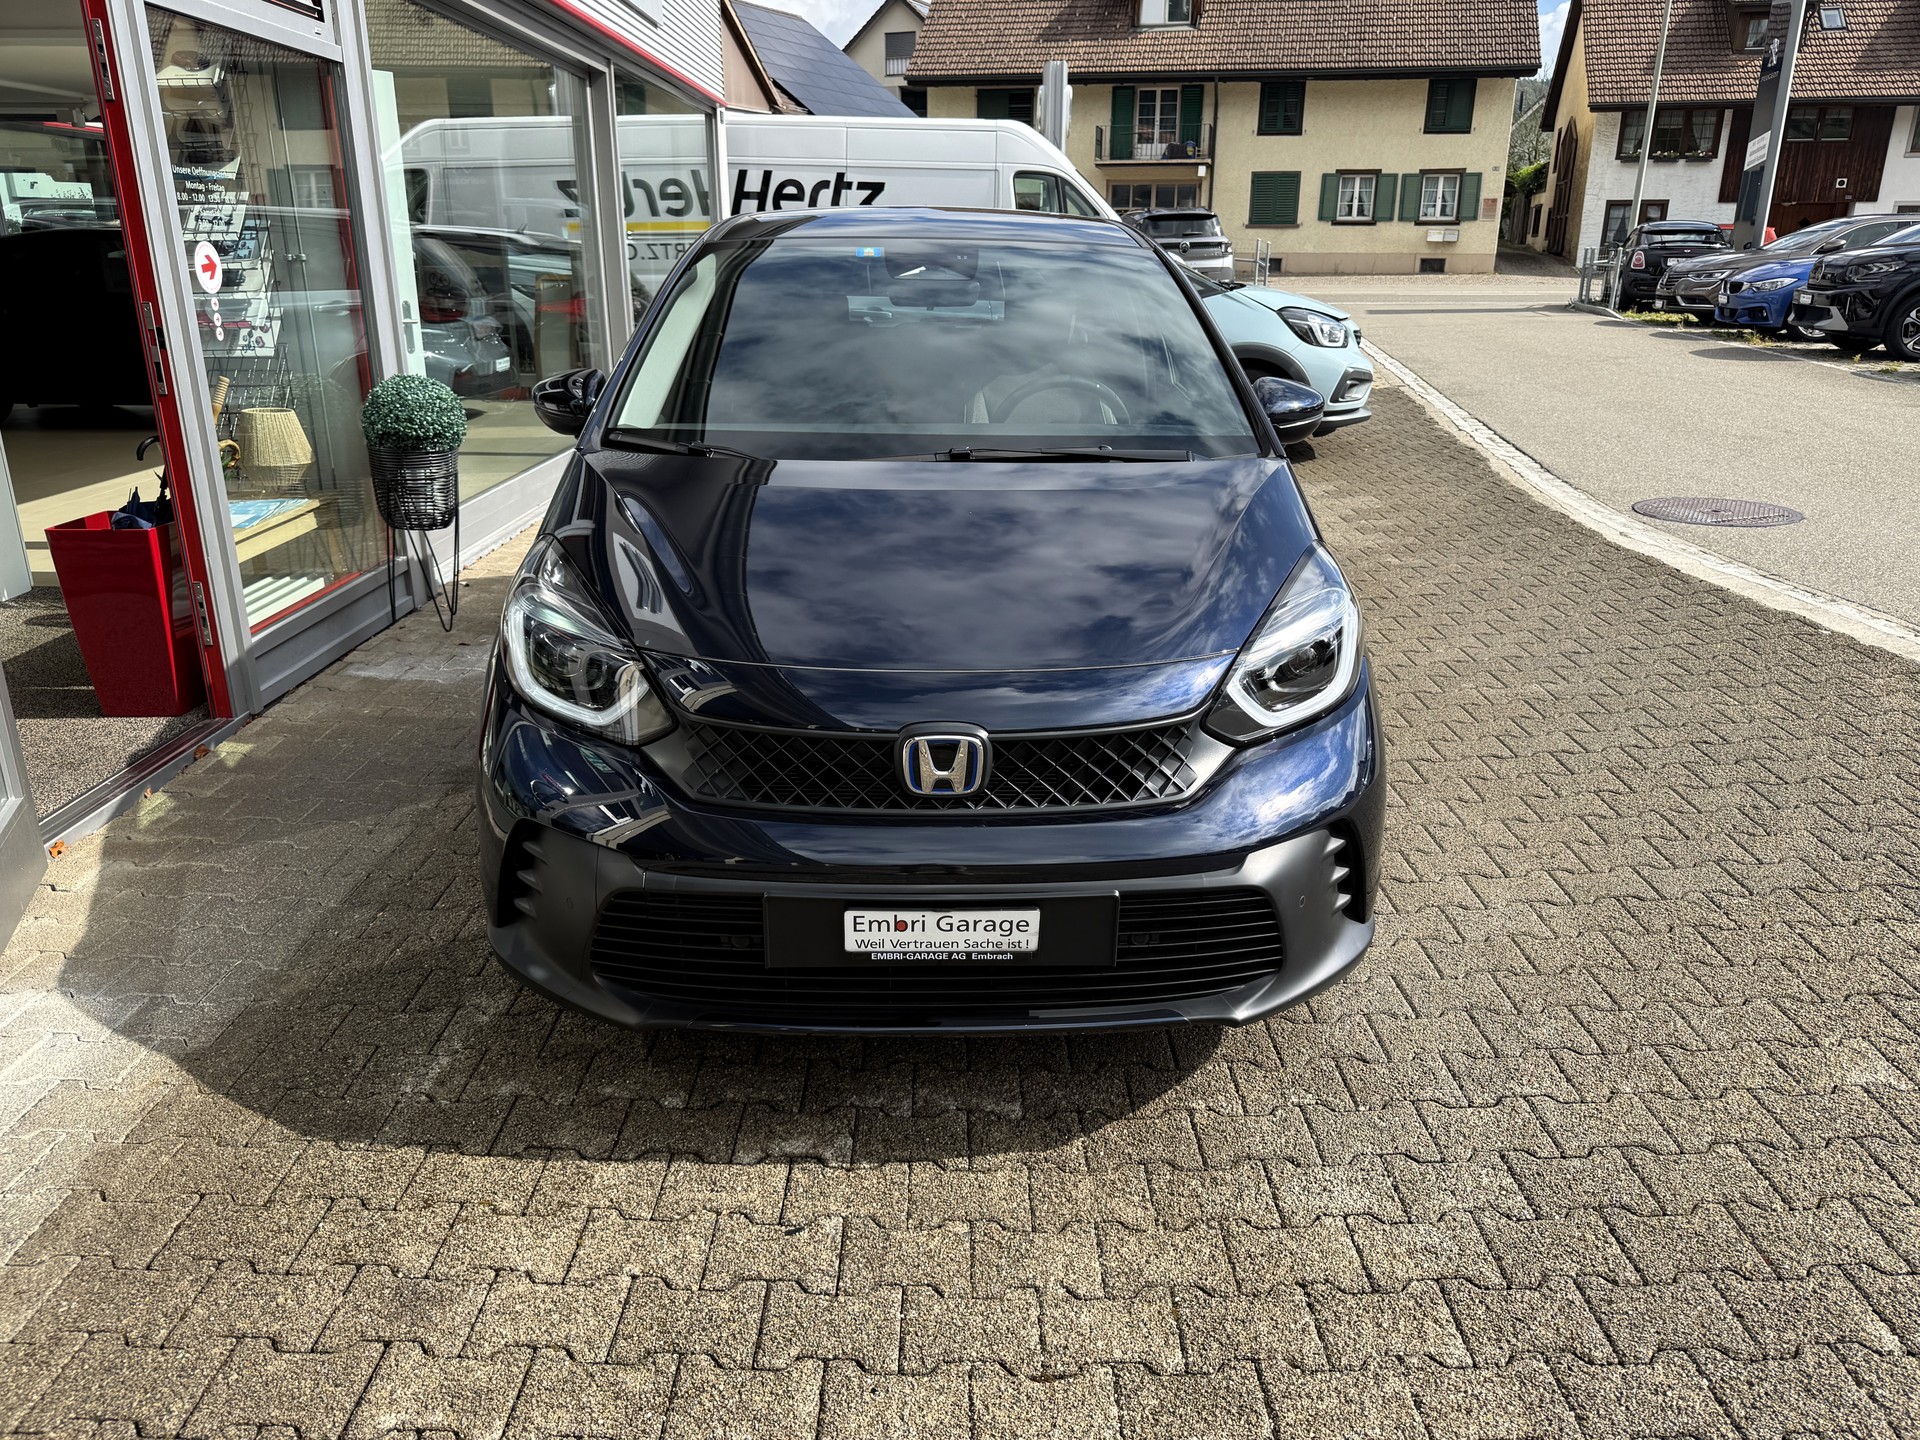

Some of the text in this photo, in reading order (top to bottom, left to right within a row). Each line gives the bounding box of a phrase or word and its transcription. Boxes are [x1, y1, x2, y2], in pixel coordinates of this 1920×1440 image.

[172, 164, 191, 174] Unsere
[185, 181, 206, 192] Montag
[208, 183, 226, 194] Freitag
[731, 169, 885, 214] Hertz
[192, 193, 205, 202] 12.00
[853, 914, 1030, 937] Embri Garage
[855, 938, 885, 949] Weil
[890, 938, 959, 949] Vertrauen
[964, 938, 1003, 949] Sache
[871, 952, 1014, 960] EMBRI-GARAGE AG Embrach
